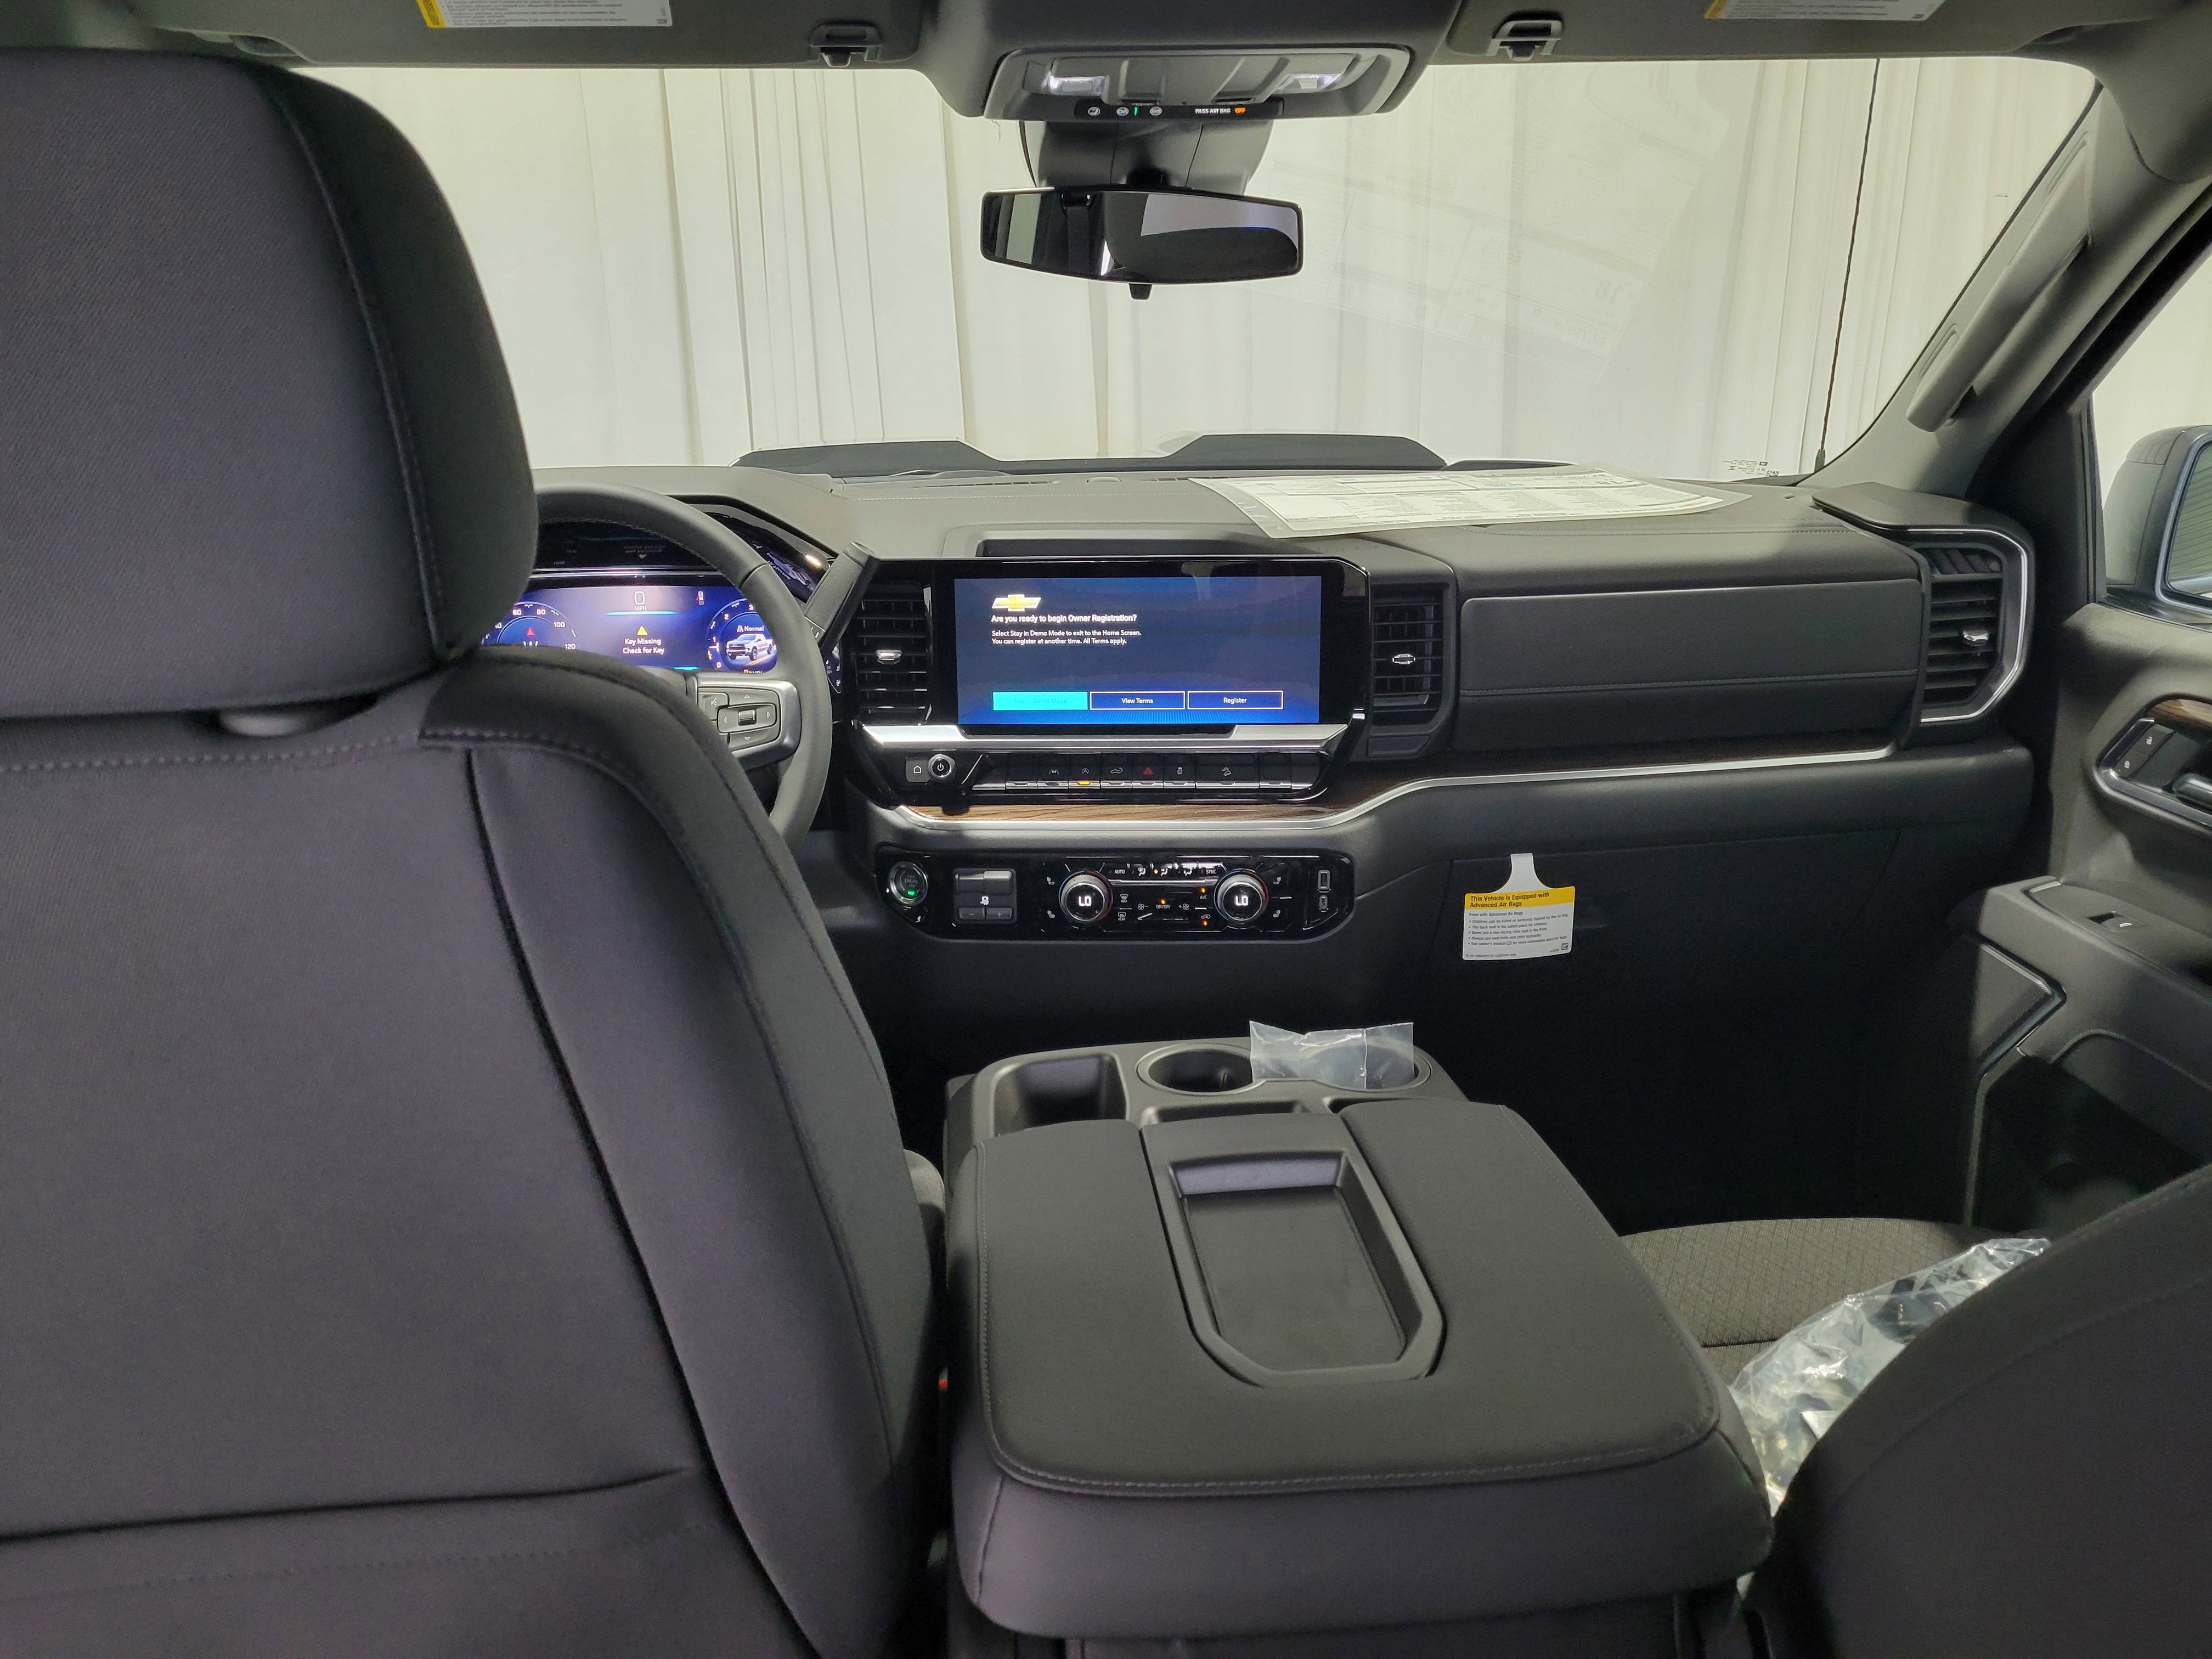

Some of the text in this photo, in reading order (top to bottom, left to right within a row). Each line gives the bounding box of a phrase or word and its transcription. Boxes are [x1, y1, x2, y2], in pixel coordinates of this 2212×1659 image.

[634, 591, 645, 605] 0
[1018, 614, 1039, 623] ready
[1047, 614, 1066, 623] begin
[1092, 614, 1137, 623] Registration?
[637, 638, 662, 646] Missing
[1109, 637, 1127, 645] apply.
[1223, 697, 1248, 705] Register
[1512, 893, 1537, 901] Equipped
